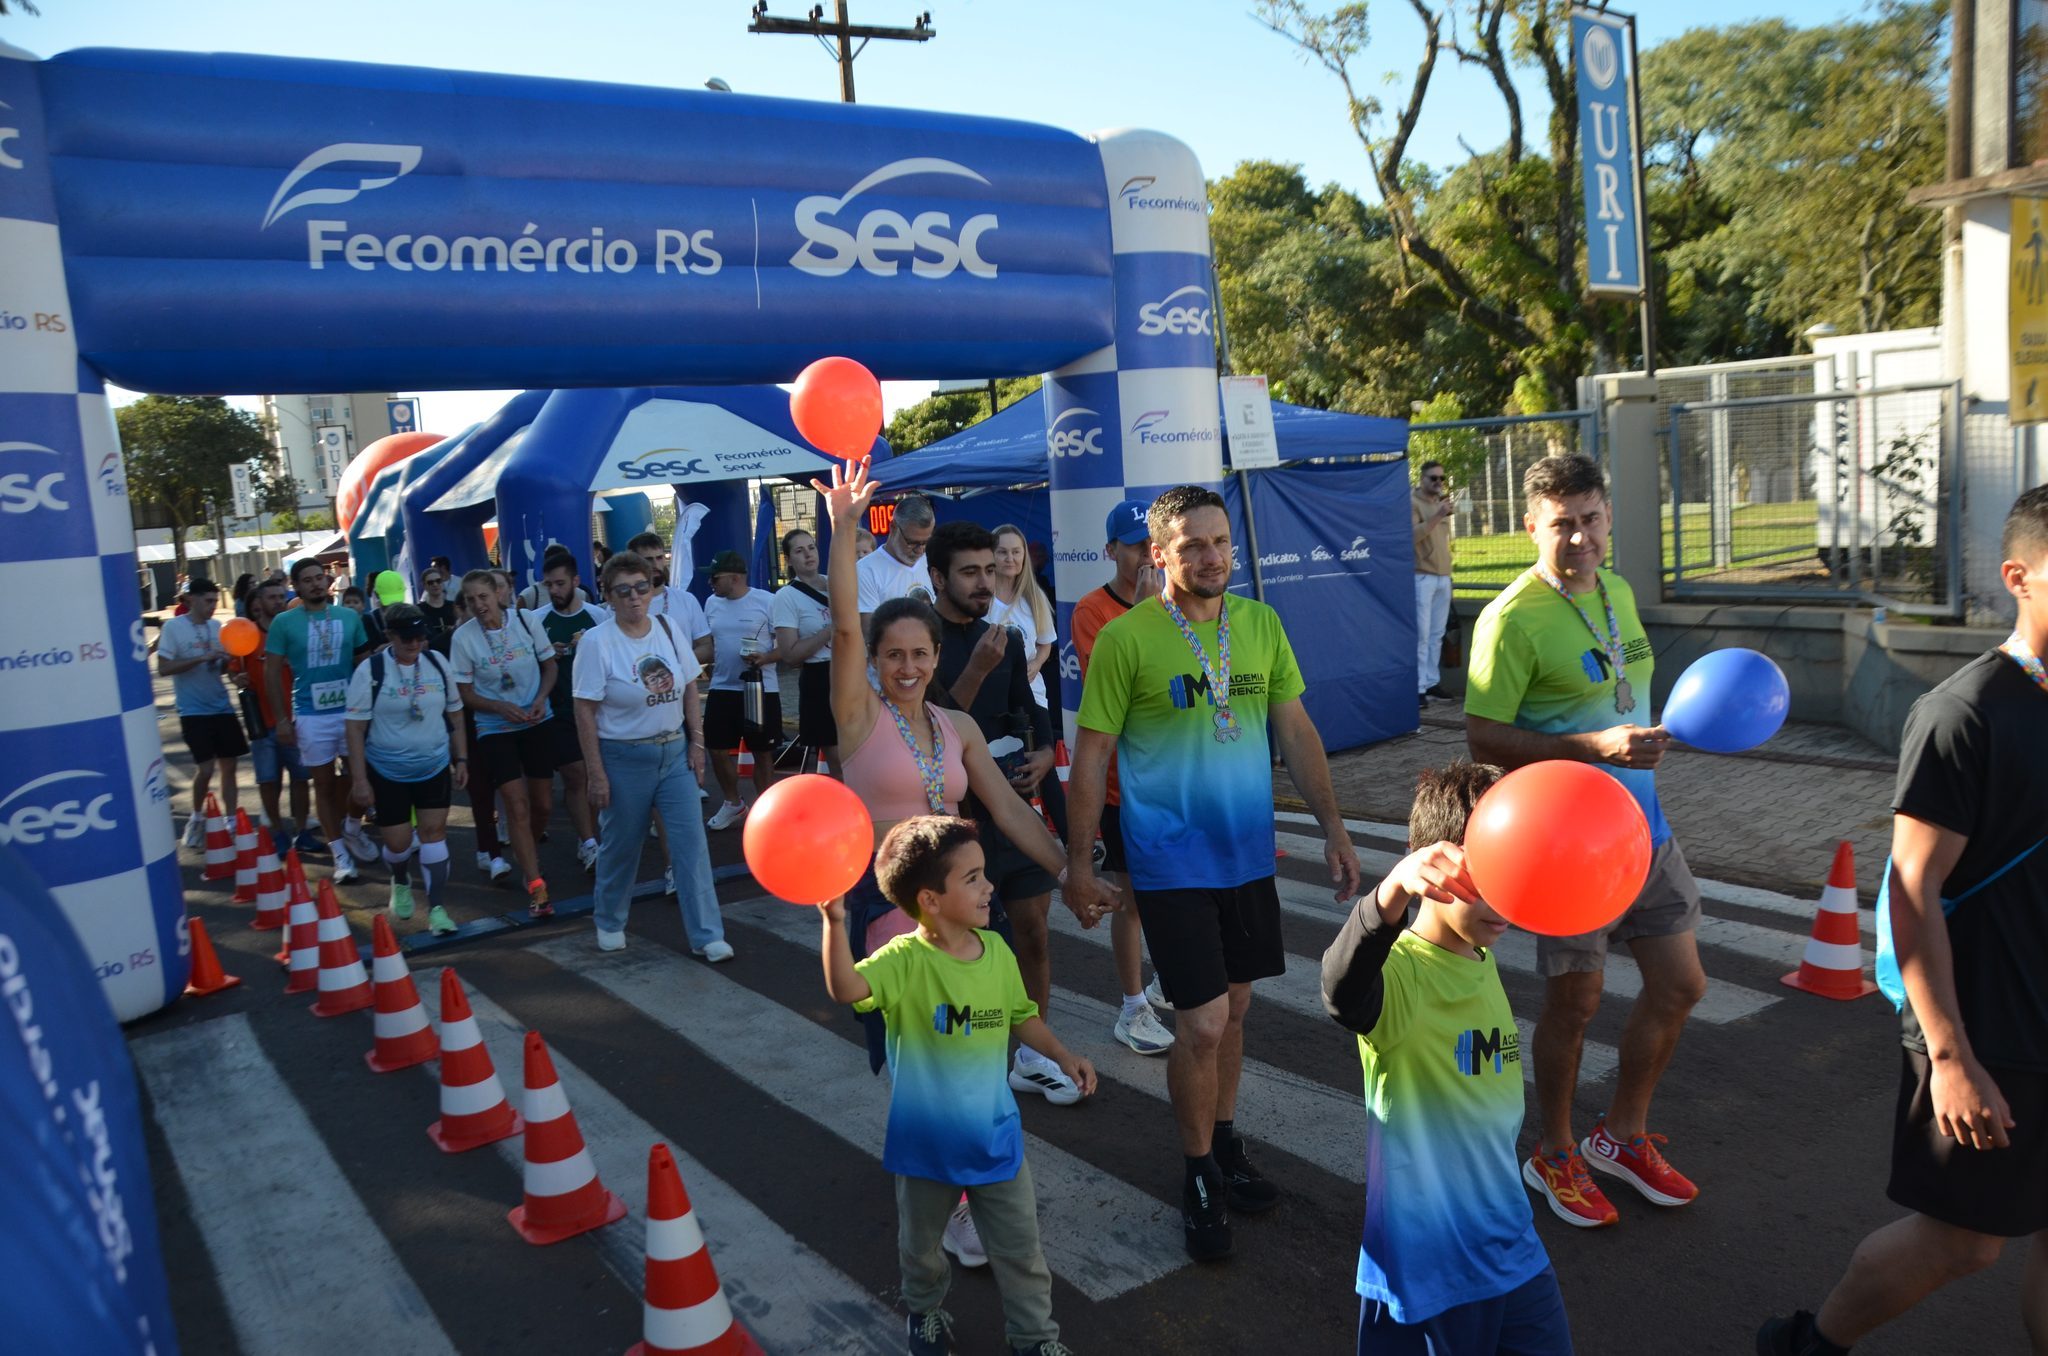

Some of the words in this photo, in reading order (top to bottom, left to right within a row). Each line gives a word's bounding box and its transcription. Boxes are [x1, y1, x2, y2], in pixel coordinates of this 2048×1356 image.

[1589, 101, 1625, 281] URI
[789, 194, 998, 279] Sesc
[307, 220, 638, 273] Fecomércio
[655, 229, 722, 276] RS
[34, 313, 67, 332] RS
[1141, 428, 1213, 445] Fecomércio
[715, 447, 792, 462] Fecomércio
[1258, 552, 1300, 567] ndicatos
[79, 641, 108, 662] RS
[1229, 672, 1265, 684] ADEMIA
[646, 689, 679, 707] GAEL
[1229, 685, 1266, 697] RENCIO
[130, 948, 156, 971] RS
